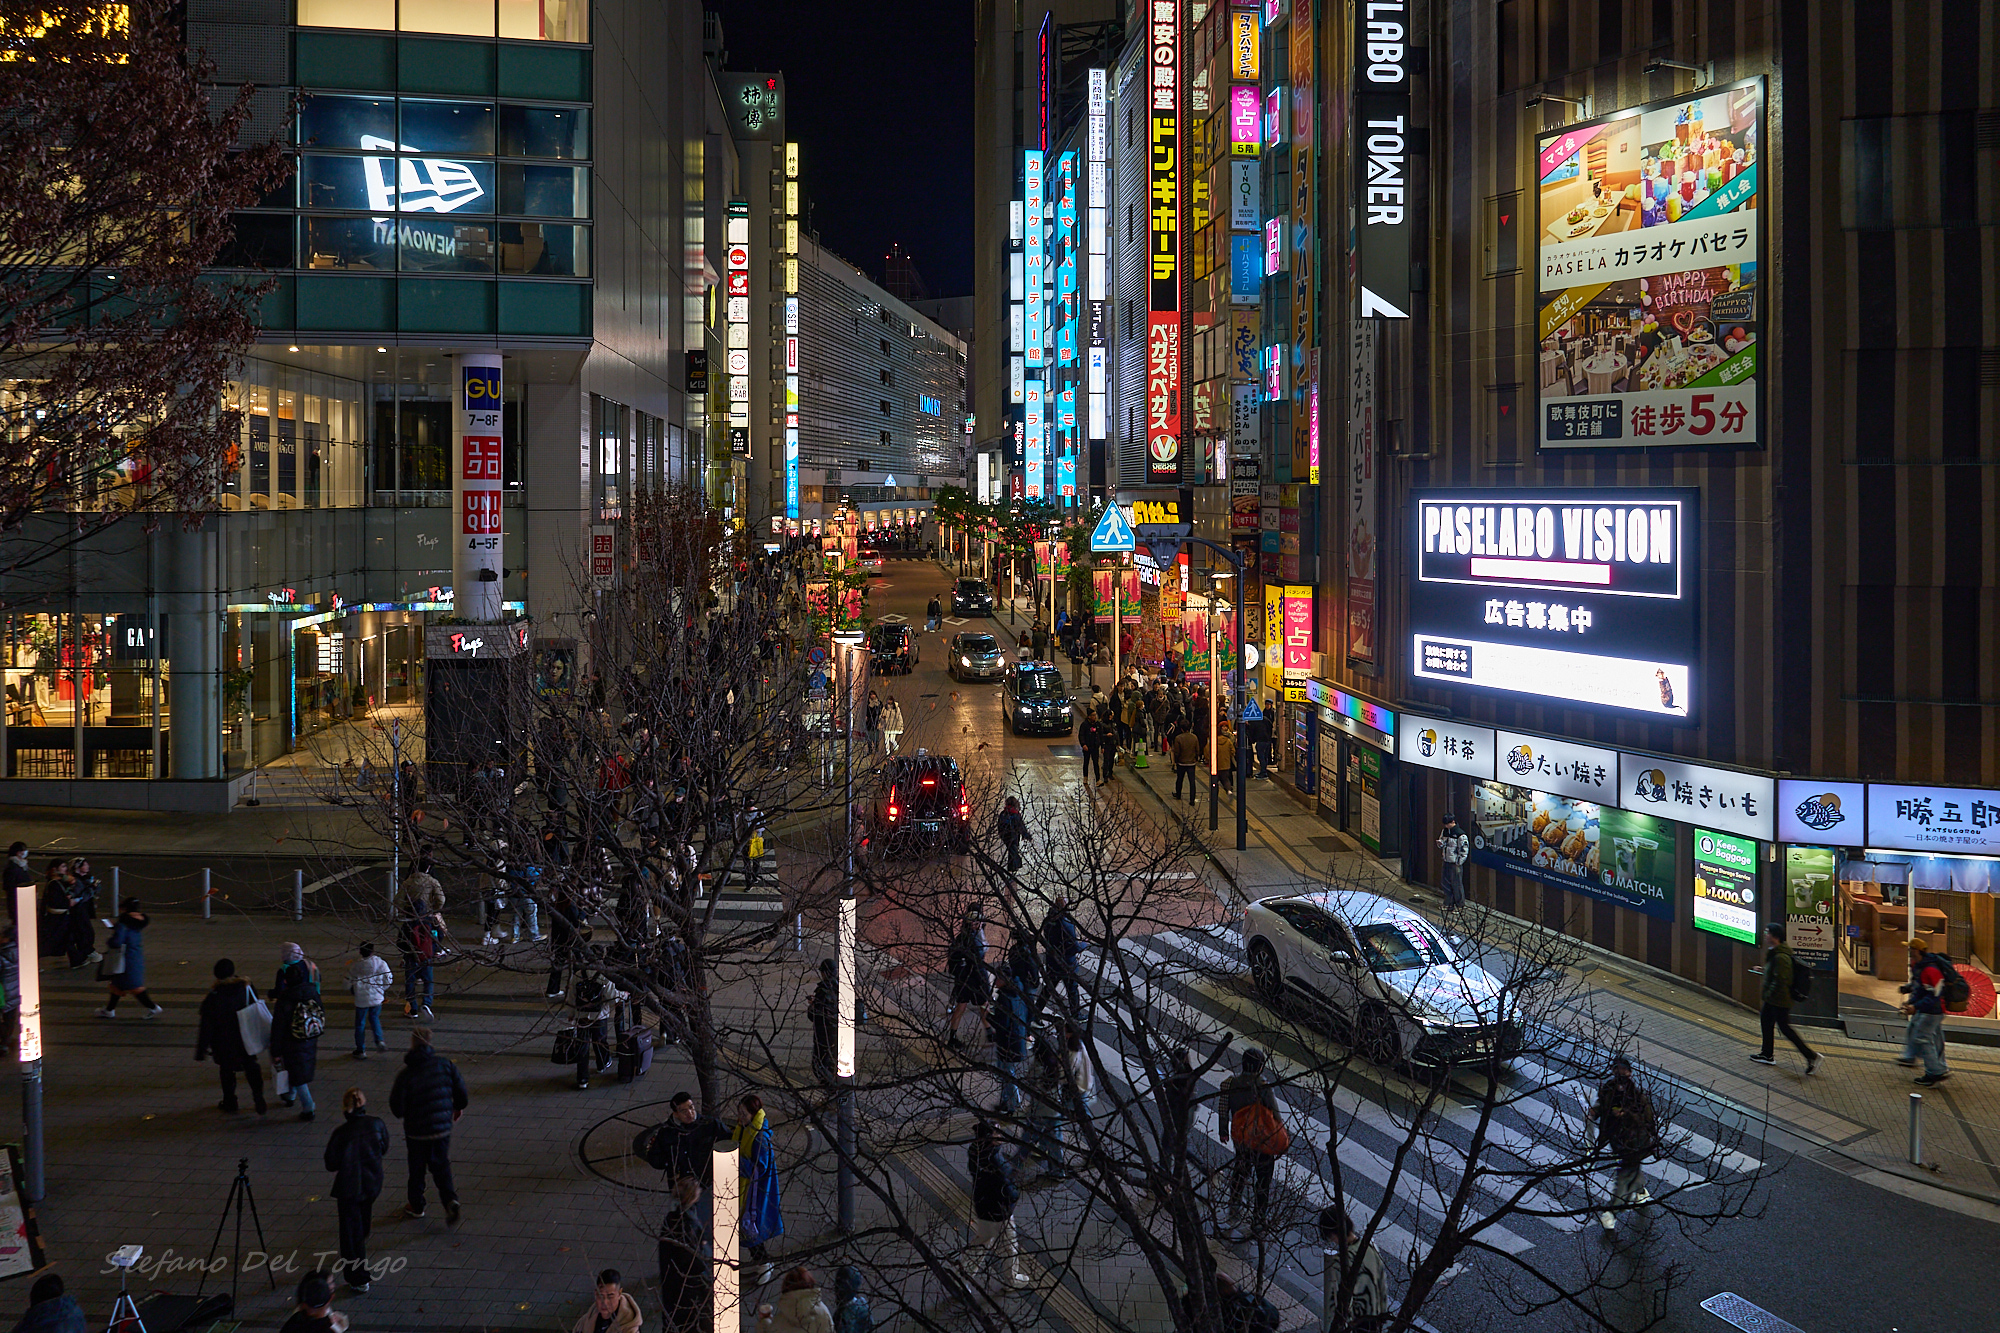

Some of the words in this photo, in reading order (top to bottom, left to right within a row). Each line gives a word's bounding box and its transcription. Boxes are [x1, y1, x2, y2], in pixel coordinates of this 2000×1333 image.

[1153, 1, 1175, 110] 驚安の殿堂
[1236, 108, 1257, 140] 占い
[1237, 144, 1254, 154] 5階
[1545, 137, 1576, 165] ママ会
[1366, 115, 1405, 226] TOWER
[1716, 179, 1752, 211] 推し会
[1546, 256, 1607, 277] PASELA
[1662, 271, 1709, 291] HAPPY
[1552, 293, 1570, 313] 貸切
[1654, 287, 1718, 312] BIRTHDAY
[1717, 298, 1740, 308] HAPPY
[1238, 311, 1256, 324] 2F
[1546, 296, 1583, 330] パーティー
[1714, 306, 1748, 316] BIRTHDAY
[1150, 324, 1168, 430] ベガスベガス
[1718, 356, 1754, 384] 誕生会
[465, 378, 500, 399] GU
[1550, 404, 1618, 421] 歌舞伎町に
[1630, 394, 1749, 437] 徒歩5分
[1565, 421, 1602, 437] 3店舗
[468, 441, 499, 456] ユニ
[1026, 390, 1040, 497] カラオケ館
[1294, 426, 1308, 460] 6F
[467, 459, 499, 474] クロ
[1234, 465, 1258, 477] 美豚
[467, 496, 498, 511] UNI
[467, 514, 499, 532] QLO
[416, 533, 439, 550] Flags
[1425, 506, 1554, 559] PASELABO
[1561, 507, 1671, 564] VISION
[429, 586, 454, 606] Flags
[1484, 598, 1592, 634] 広告募集中
[450, 633, 484, 658] Flags
[1286, 626, 1311, 664] 占い
[1443, 735, 1475, 761] 抹茶
[1537, 754, 1606, 787] たい焼き
[1671, 779, 1758, 817] 焼きいも
[1895, 796, 2000, 829] 勝五郎
[1715, 847, 1752, 866] Baggage
[1716, 839, 1737, 853] Keep
[1549, 857, 1588, 878] TAIYAKI
[1700, 862, 1719, 873] Baggage
[1615, 875, 1665, 900] MATCHA
[1711, 910, 1751, 927] 11:00-22:00
[1789, 913, 1830, 925] MATCHA
[1796, 941, 1823, 949] Counter
